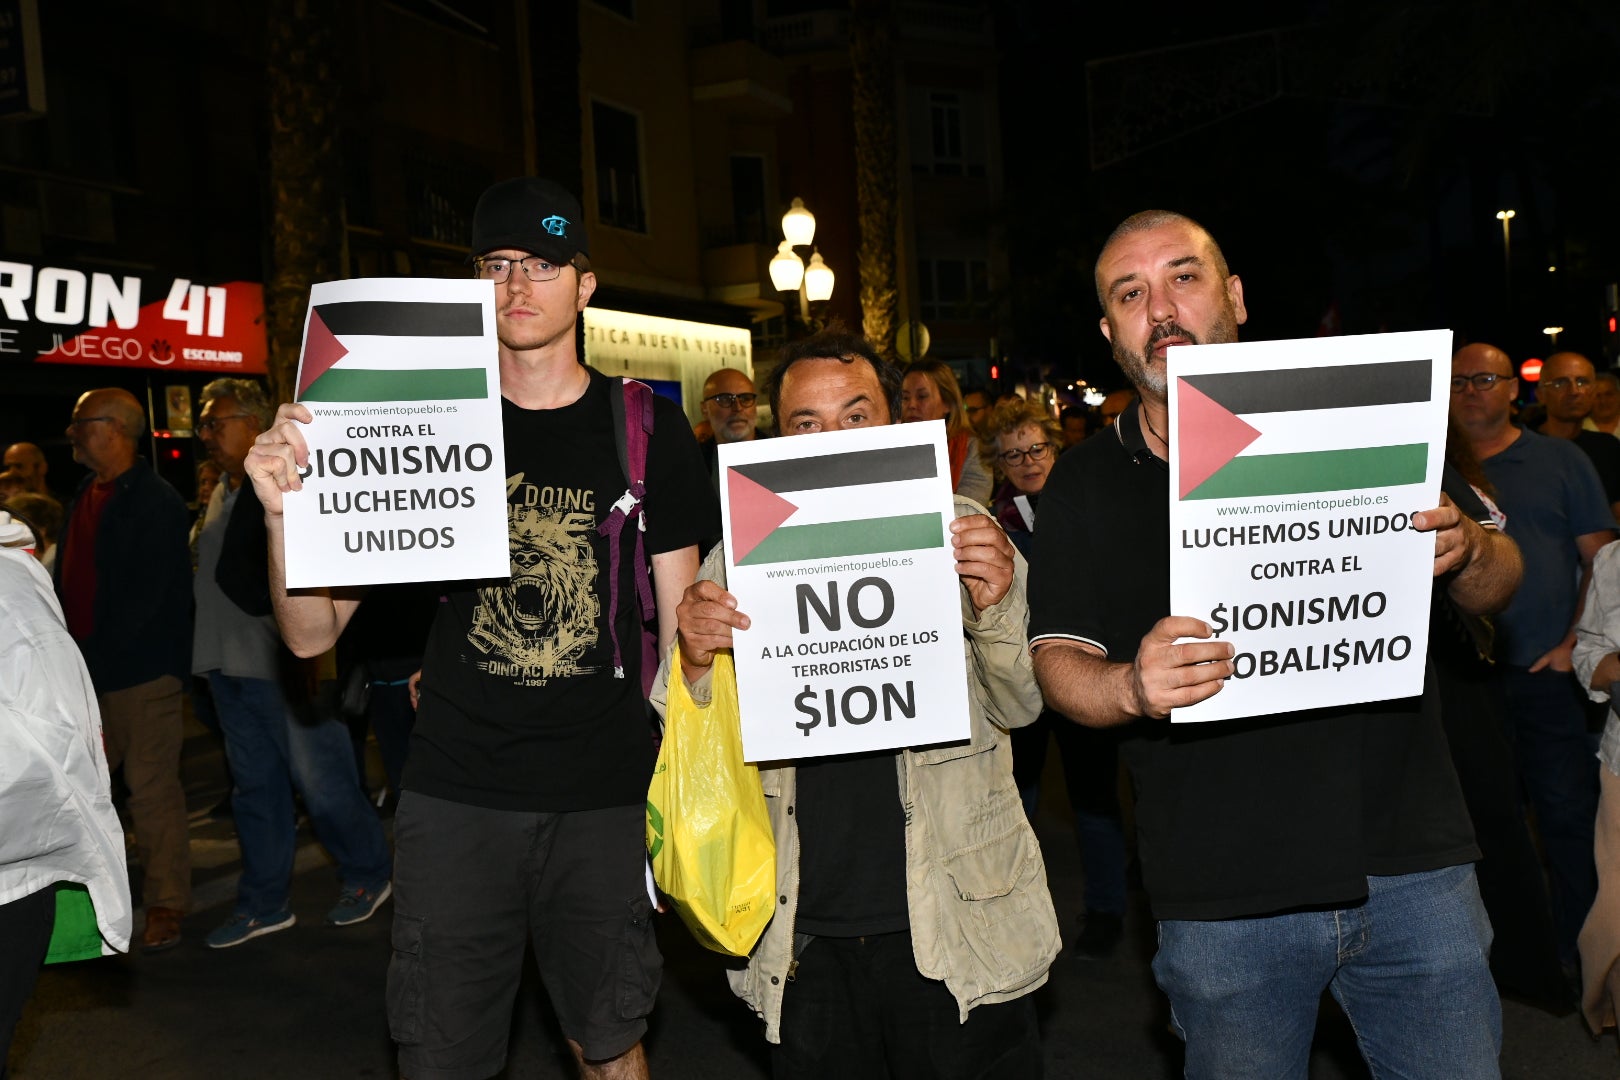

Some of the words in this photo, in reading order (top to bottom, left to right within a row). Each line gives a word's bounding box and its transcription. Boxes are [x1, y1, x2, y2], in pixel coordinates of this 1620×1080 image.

[0, 261, 141, 330] RON
[163, 278, 227, 338] 41
[37, 332, 143, 361] JUEGO
[638, 333, 690, 351] NUEVA
[182, 348, 243, 363] ESCOLANO
[314, 404, 458, 418] www.movimientopueblo.es
[346, 424, 414, 439] CONTRA
[418, 423, 436, 436] EL
[318, 486, 476, 515] LUCHEMOS
[1216, 494, 1389, 516] www.movimientopueblo.es
[344, 527, 456, 553] UNIDOS
[1182, 520, 1320, 549] LUCHEMOS
[766, 556, 914, 579] www.movimientopueblo.es
[1250, 557, 1335, 580] CONTRA
[1341, 555, 1362, 572] EL
[795, 576, 895, 634] NO
[1210, 591, 1387, 638] $IONISMO
[761, 647, 772, 659] A
[776, 645, 793, 658] LA
[797, 634, 885, 657] OCUPACIÓN
[889, 633, 908, 647] DE
[912, 630, 939, 644] LOS
[488, 661, 519, 677] DINO
[792, 657, 889, 678] TERRORISTAS
[893, 655, 912, 667] DE
[1223, 635, 1412, 681] OBALI$MO
[794, 680, 916, 736] $ION
